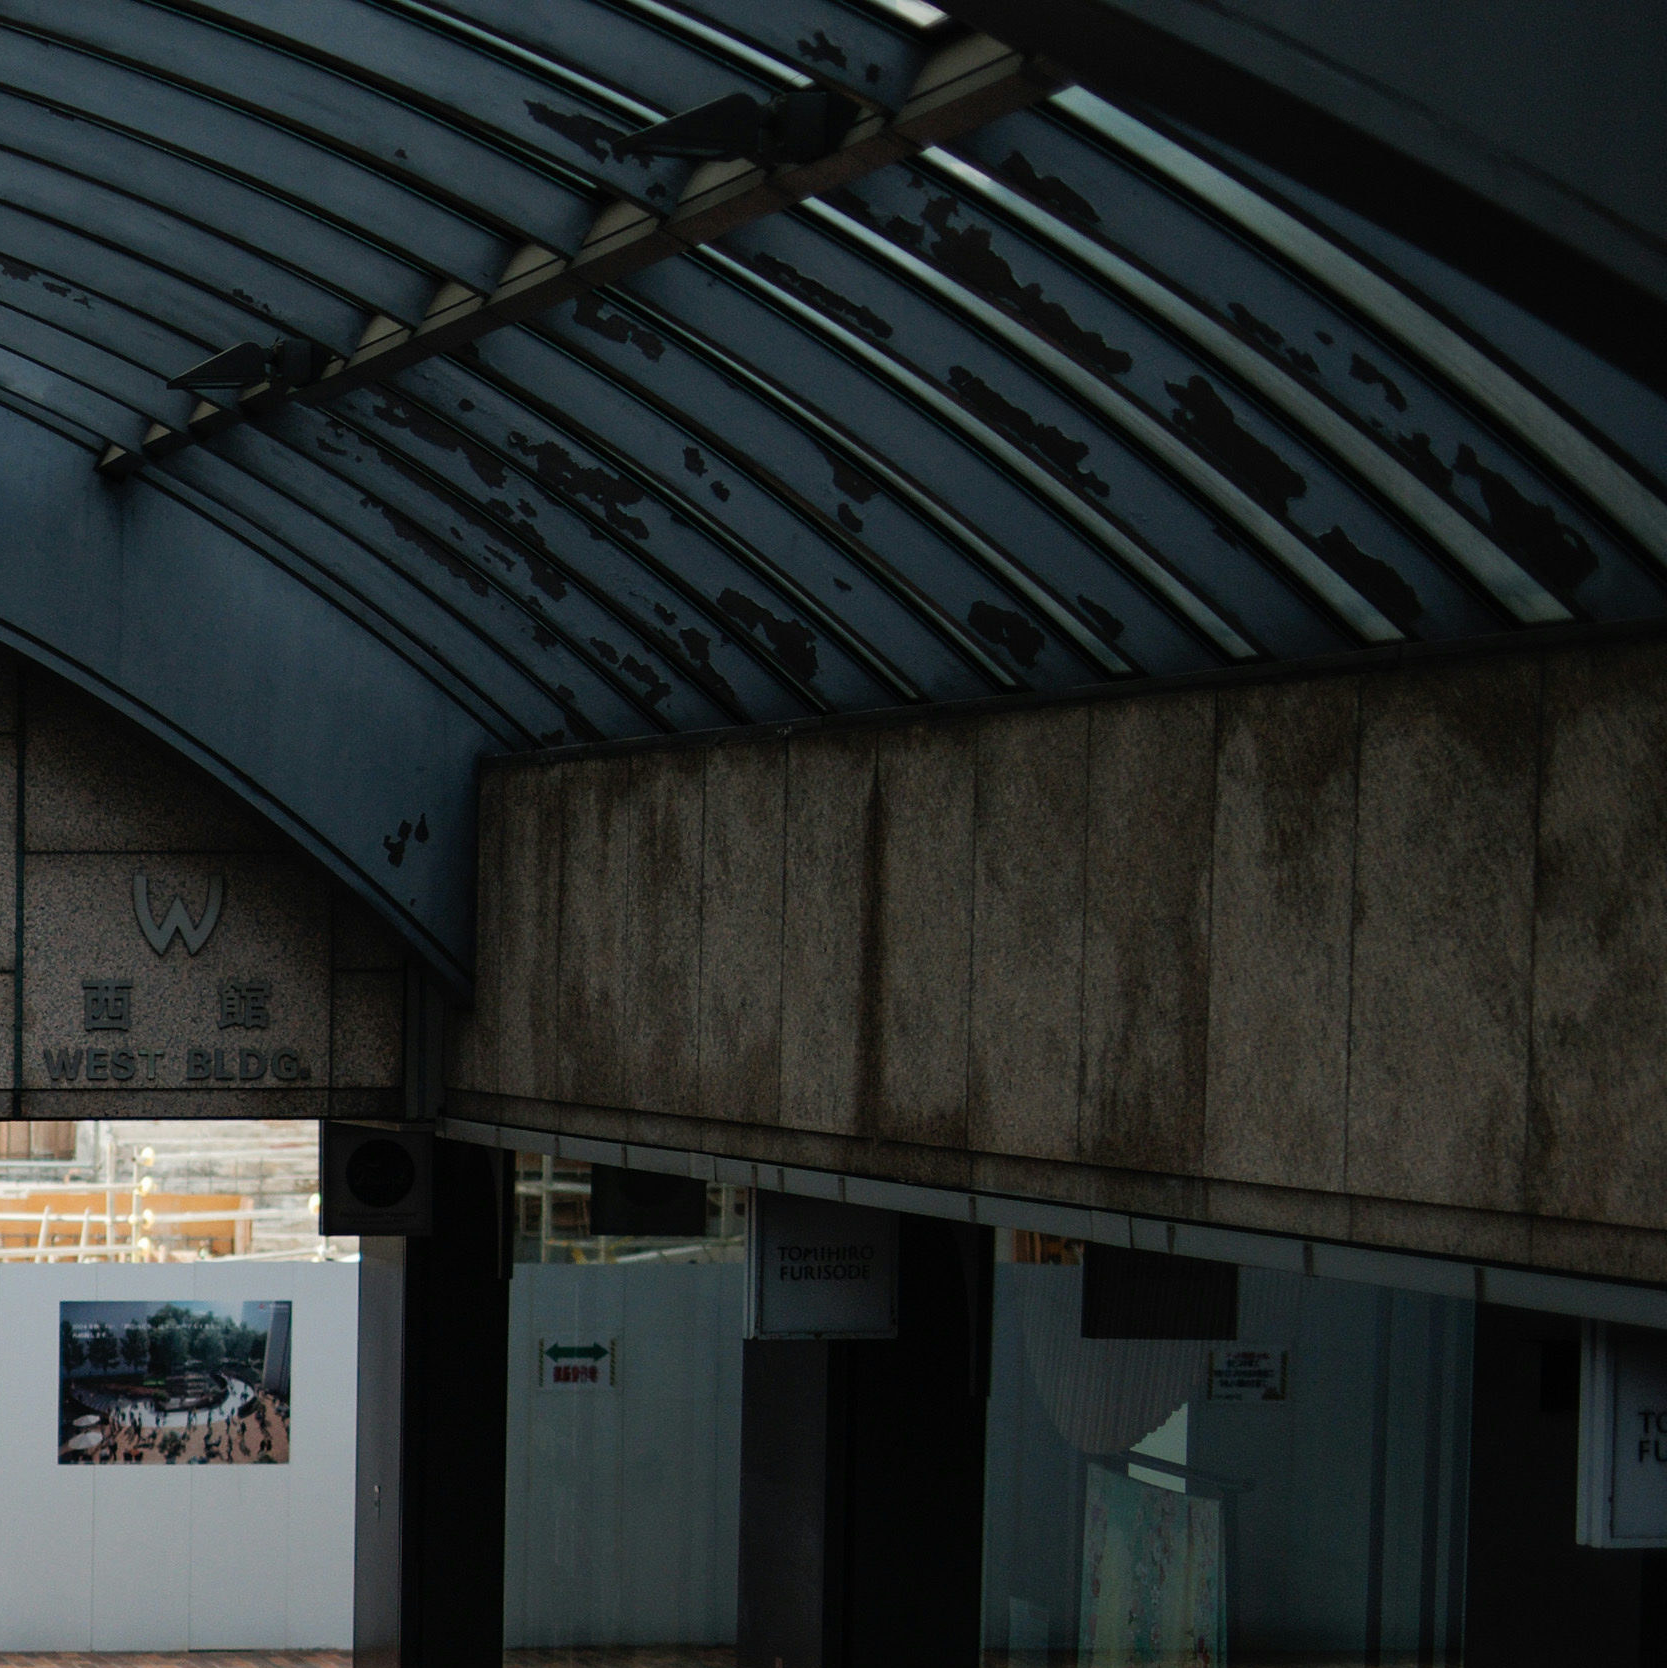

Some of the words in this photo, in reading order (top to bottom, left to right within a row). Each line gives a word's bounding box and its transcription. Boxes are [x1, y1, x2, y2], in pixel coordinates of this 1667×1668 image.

[82, 977, 272, 1032] 西館
[43, 1047, 164, 1082] WEST
[186, 1047, 312, 1082] BLDG.
[778, 1246, 874, 1261] TOMIHIRO
[780, 1264, 871, 1280] FURISODE
